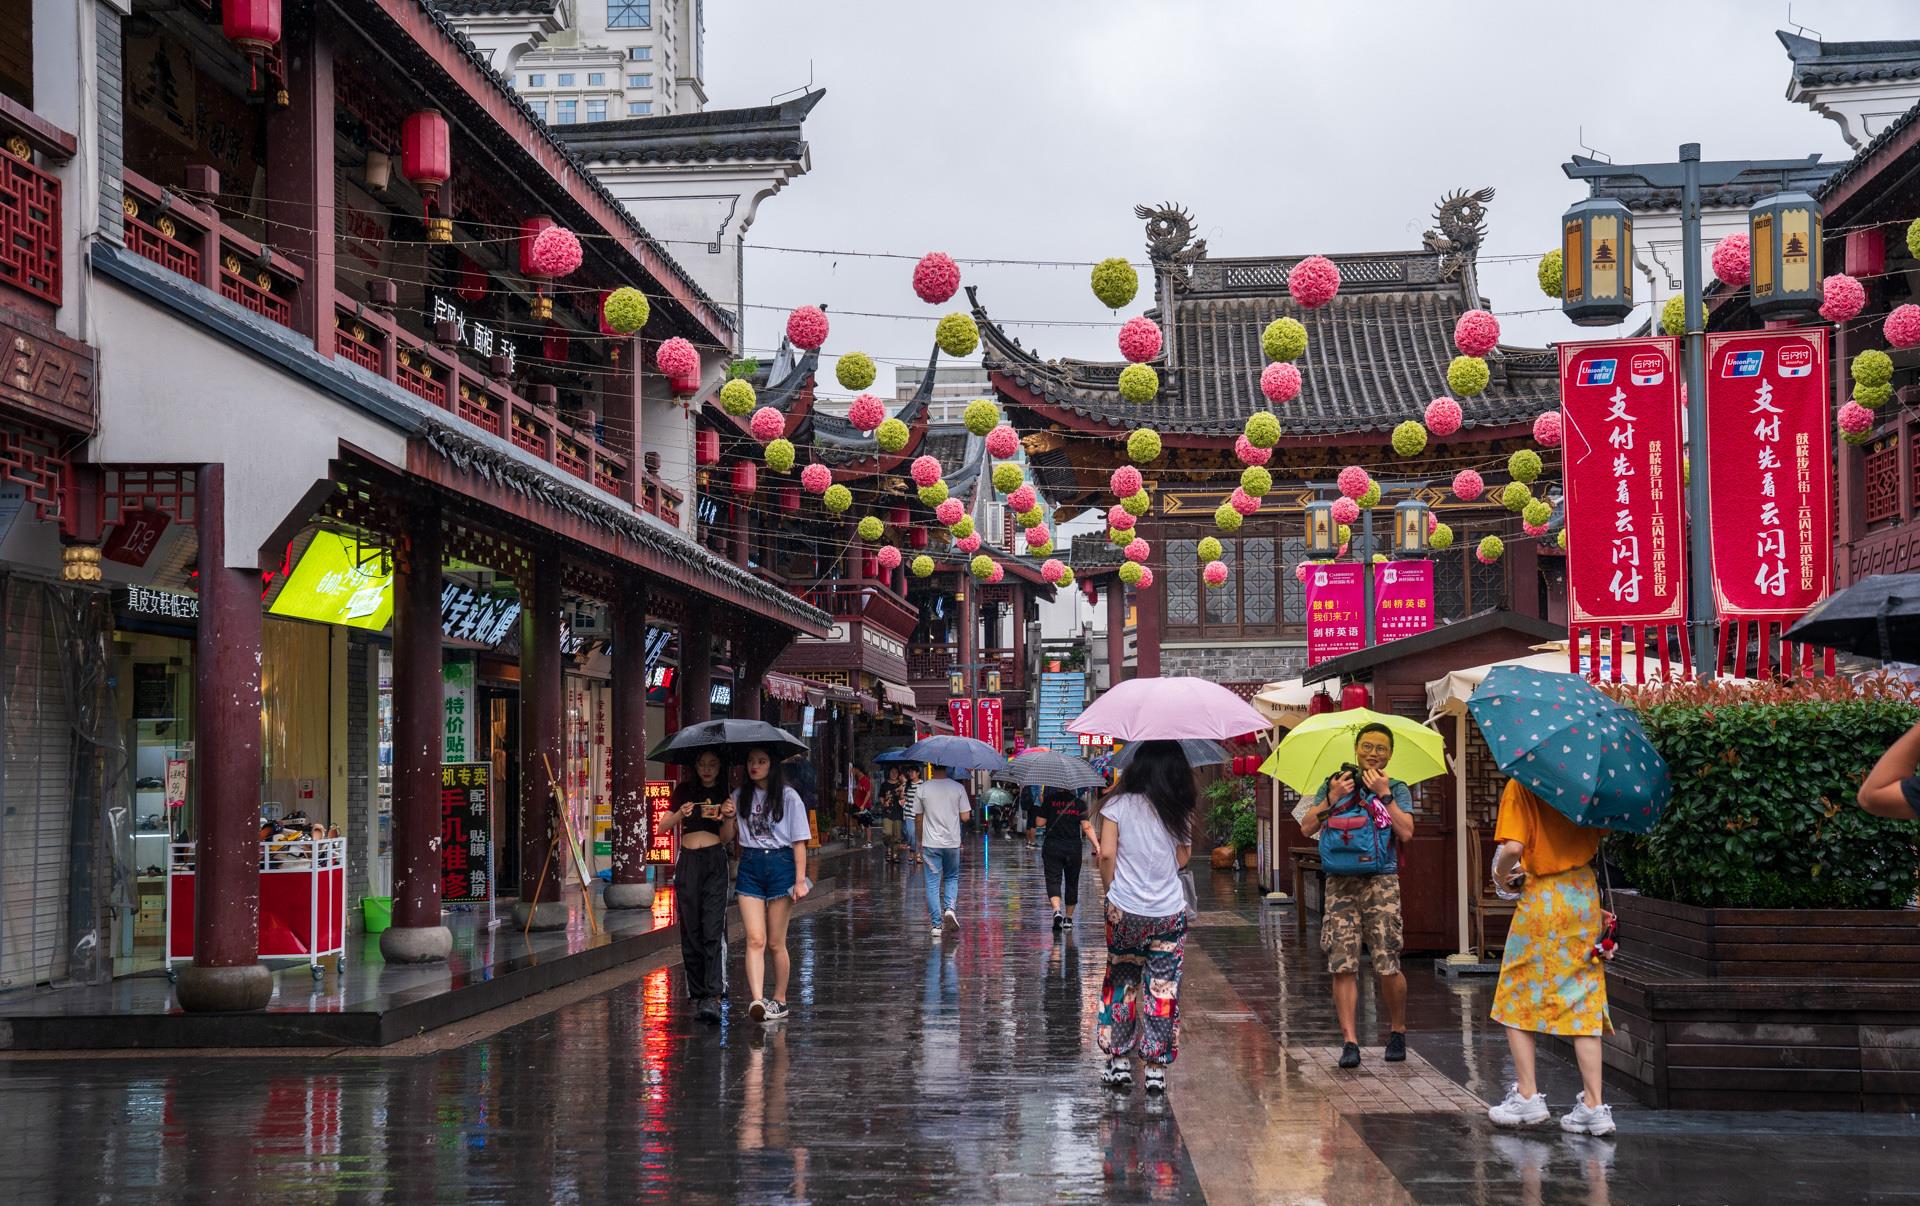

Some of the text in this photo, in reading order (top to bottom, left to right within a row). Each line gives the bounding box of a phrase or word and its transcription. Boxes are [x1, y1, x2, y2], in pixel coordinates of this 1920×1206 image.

[1633, 359, 1661, 369] 云闪付
[1780, 351, 1809, 360] 云闪付
[1603, 386, 1643, 603] 支付先看云闪付
[1749, 377, 1789, 596] 支付先看云闪付
[1382, 598, 1427, 609] 剑桥英语
[1313, 626, 1359, 638] 剑桥英语
[469, 789, 486, 816] 配件
[469, 829, 486, 857] 贴膜
[469, 869, 486, 897] 换屏
